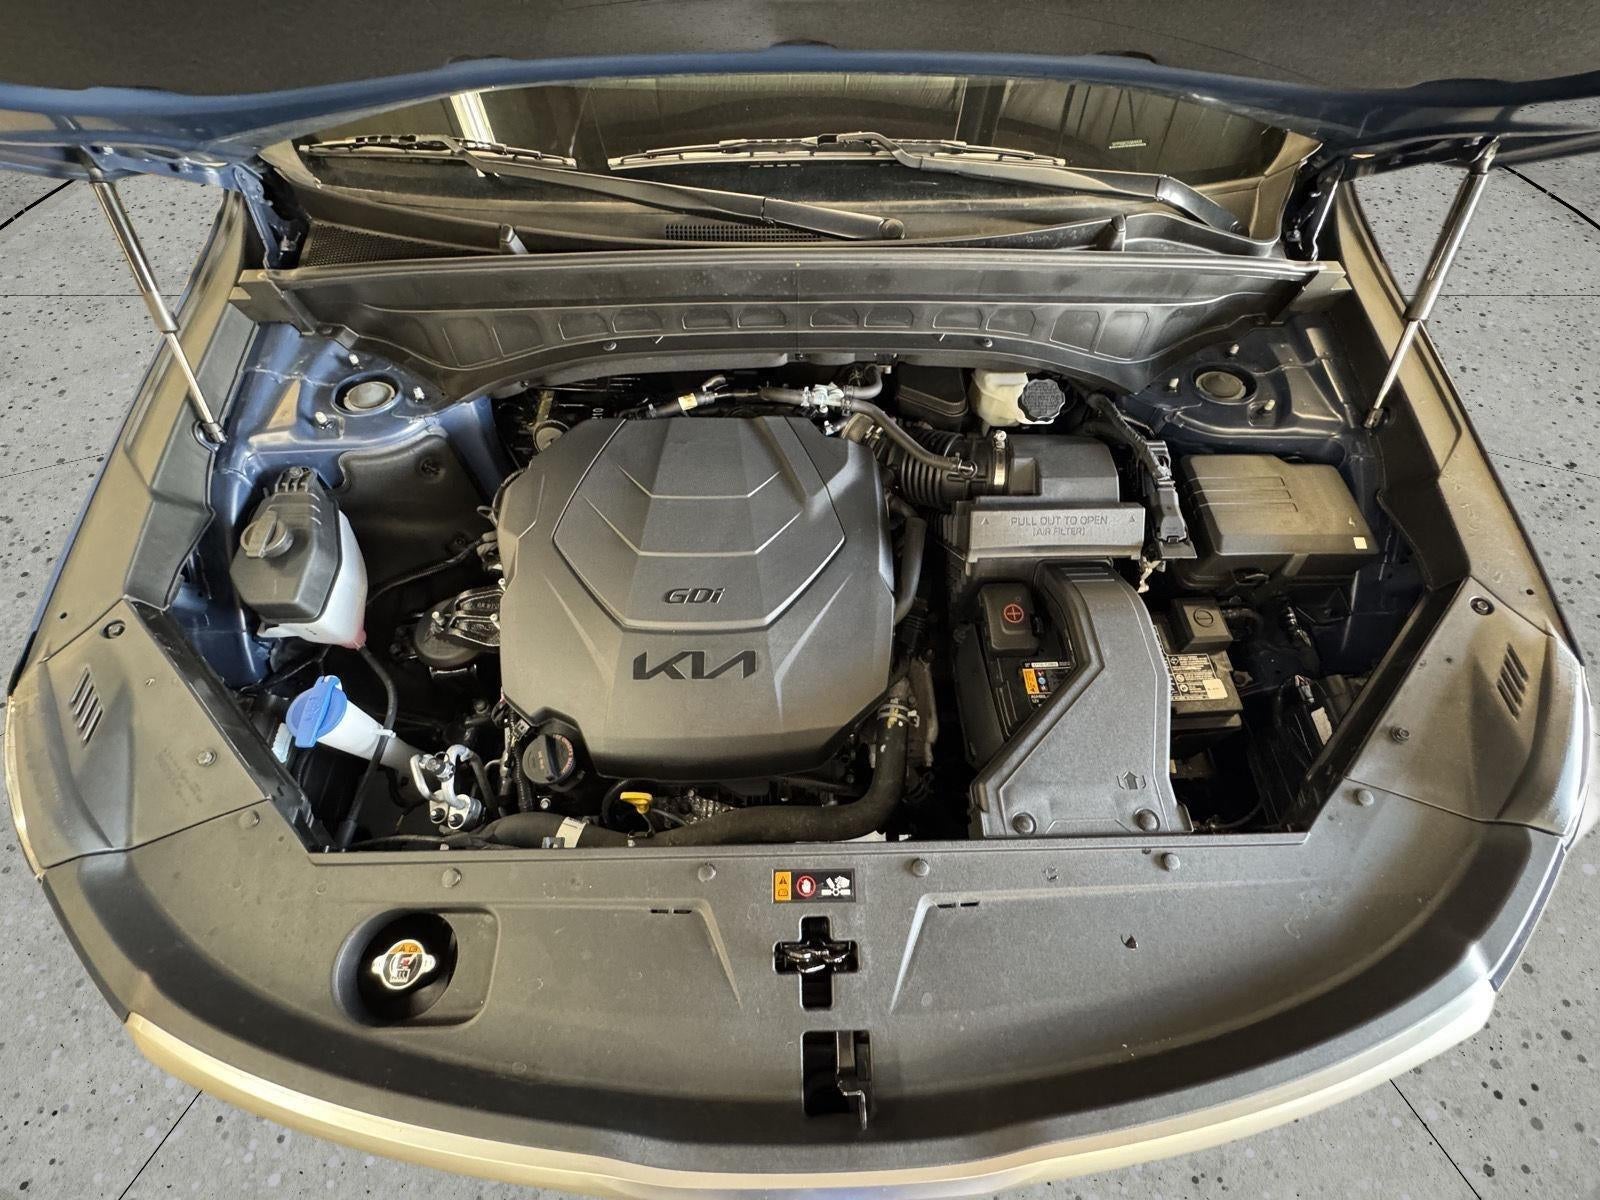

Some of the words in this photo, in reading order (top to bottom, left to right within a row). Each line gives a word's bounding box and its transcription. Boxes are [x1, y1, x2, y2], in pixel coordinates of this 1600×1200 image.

[1011, 516, 1037, 526] PULL
[1040, 516, 1061, 526] OUT
[1064, 515, 1078, 526] TO
[1080, 515, 1108, 525] OPEN
[1053, 526, 1086, 536] FILTER)
[664, 587, 725, 604] GDi
[633, 650, 757, 680] KIA
